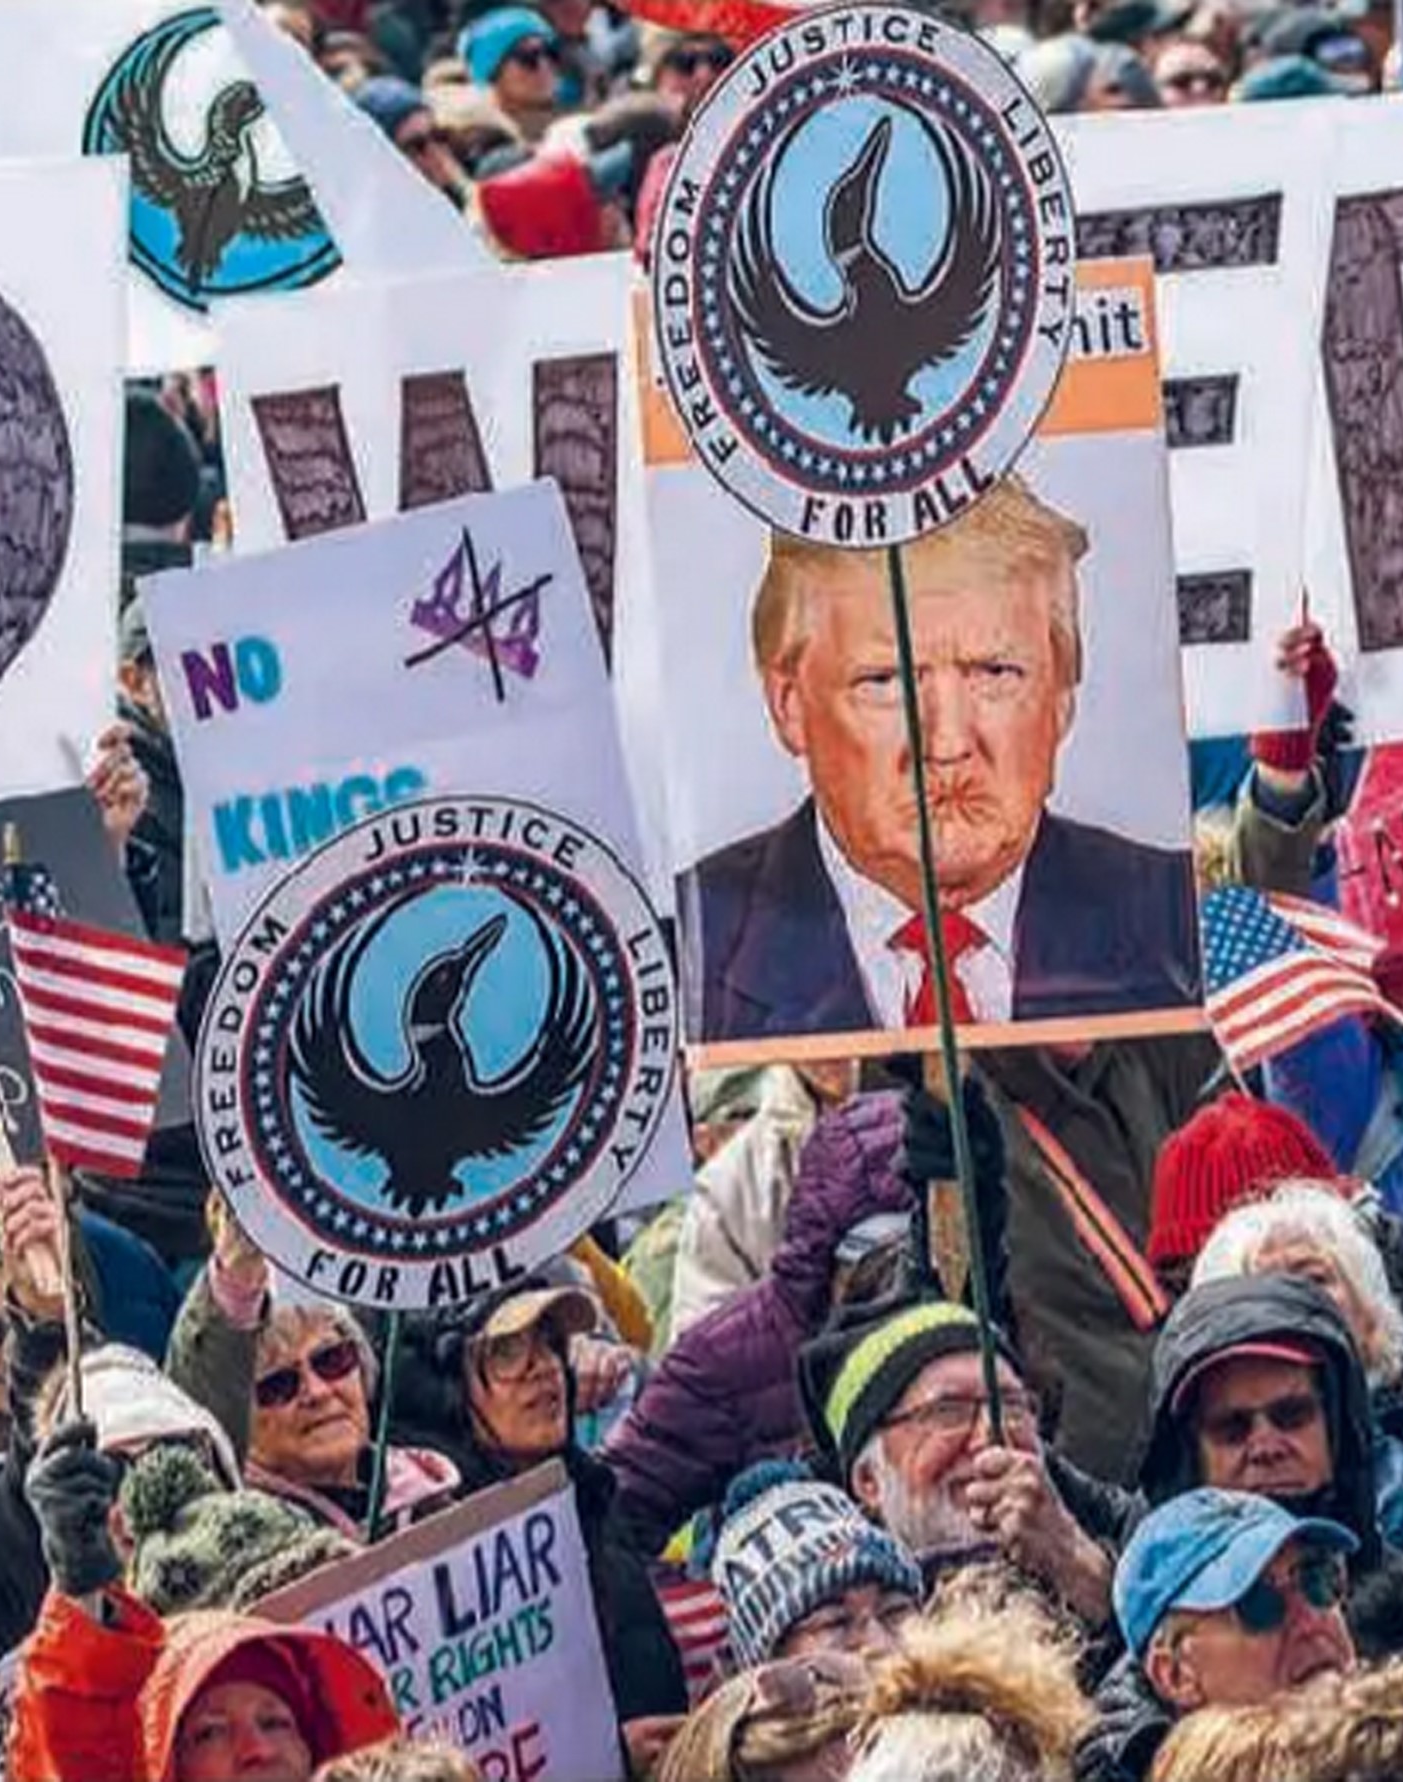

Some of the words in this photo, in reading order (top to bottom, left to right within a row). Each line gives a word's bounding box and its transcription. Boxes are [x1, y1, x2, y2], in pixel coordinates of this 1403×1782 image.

[747, 16, 941, 97] JUSTICE
[1001, 99, 1076, 346] LIBERTY
[666, 178, 738, 465] FREEDOM
[801, 496, 888, 541] FOR
[914, 458, 996, 535] ALL
[181, 635, 282, 720] NO
[364, 807, 585, 870] JUSTICE
[212, 916, 290, 1190] FREEDOM
[609, 929, 669, 1173] LIBERTY
[305, 1249, 400, 1301] FOR
[427, 1247, 527, 1305] ALL
[433, 1511, 562, 1639] LIAR
[427, 1598, 555, 1706] RIGHTS
